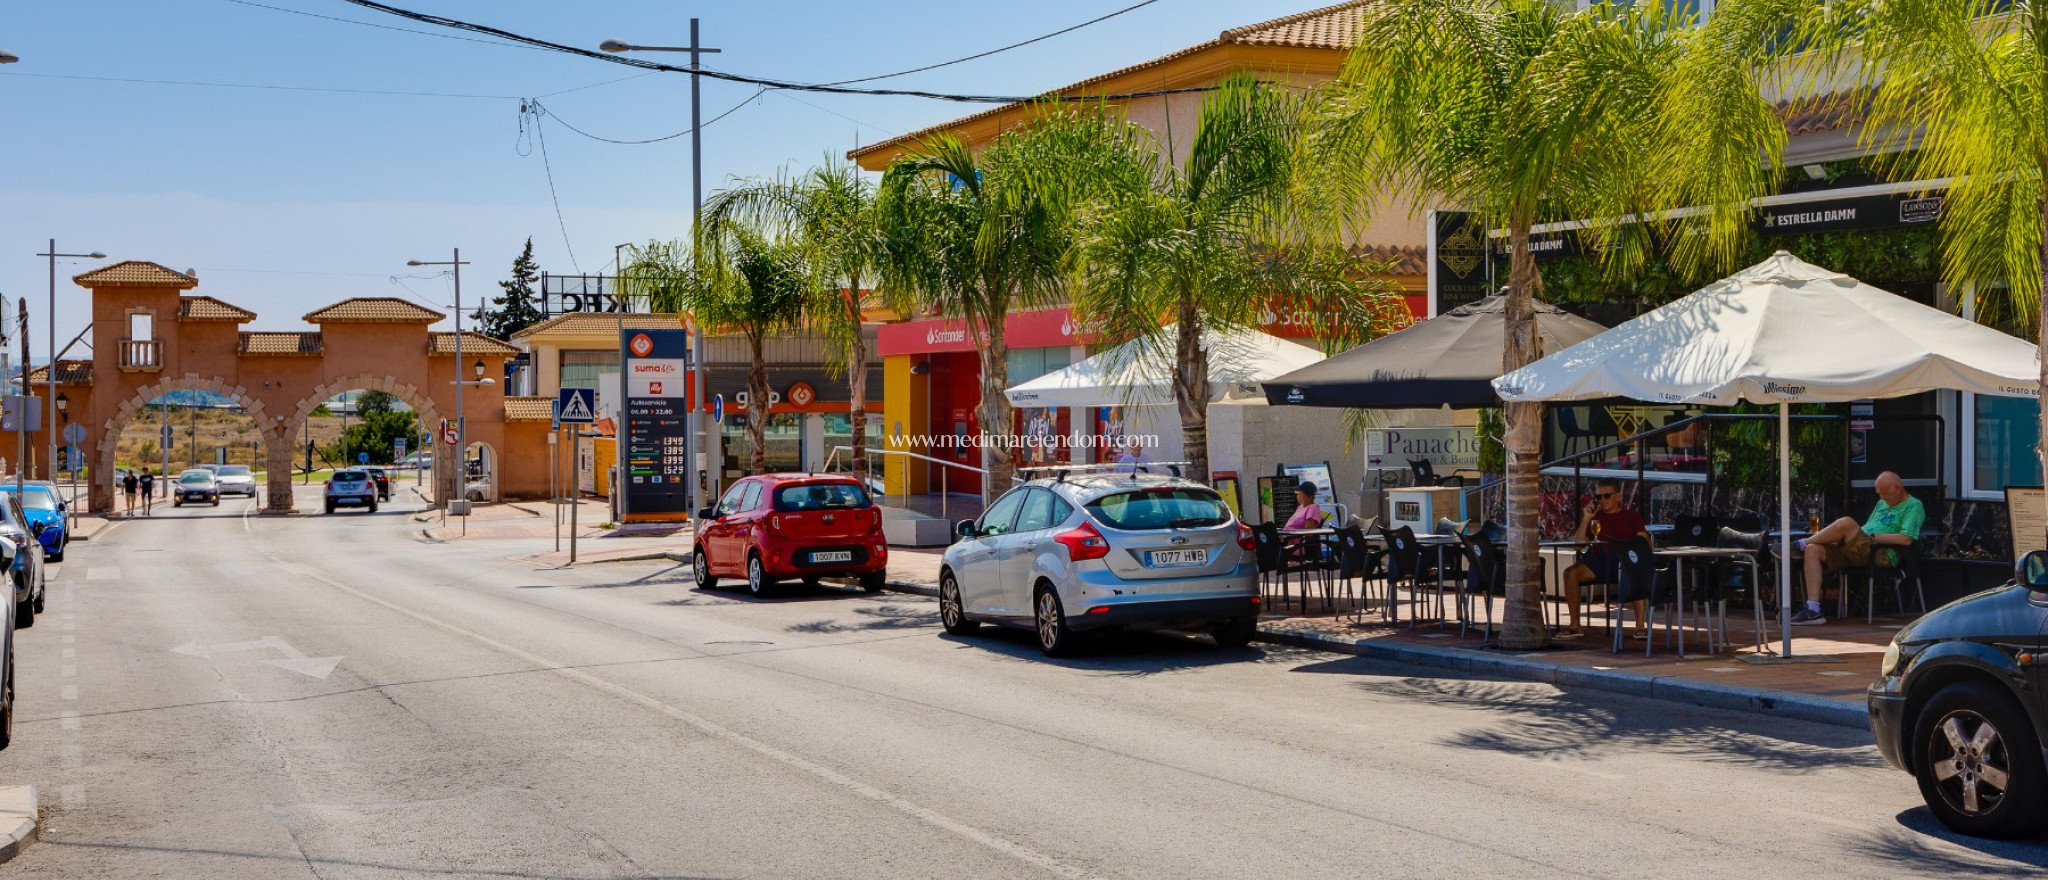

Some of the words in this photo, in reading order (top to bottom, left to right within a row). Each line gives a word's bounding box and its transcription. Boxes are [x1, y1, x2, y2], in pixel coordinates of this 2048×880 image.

[1777, 211, 1823, 226] ESTRELLA
[1824, 208, 1856, 222] DAMM
[1505, 242, 1539, 254] ESLLA
[1540, 240, 1563, 251] DAMM
[934, 328, 965, 344] Santander
[634, 364, 660, 373] suma
[2006, 386, 2030, 395] GUSTO
[815, 553, 833, 561] 1007
[1154, 551, 1181, 563] 1077
